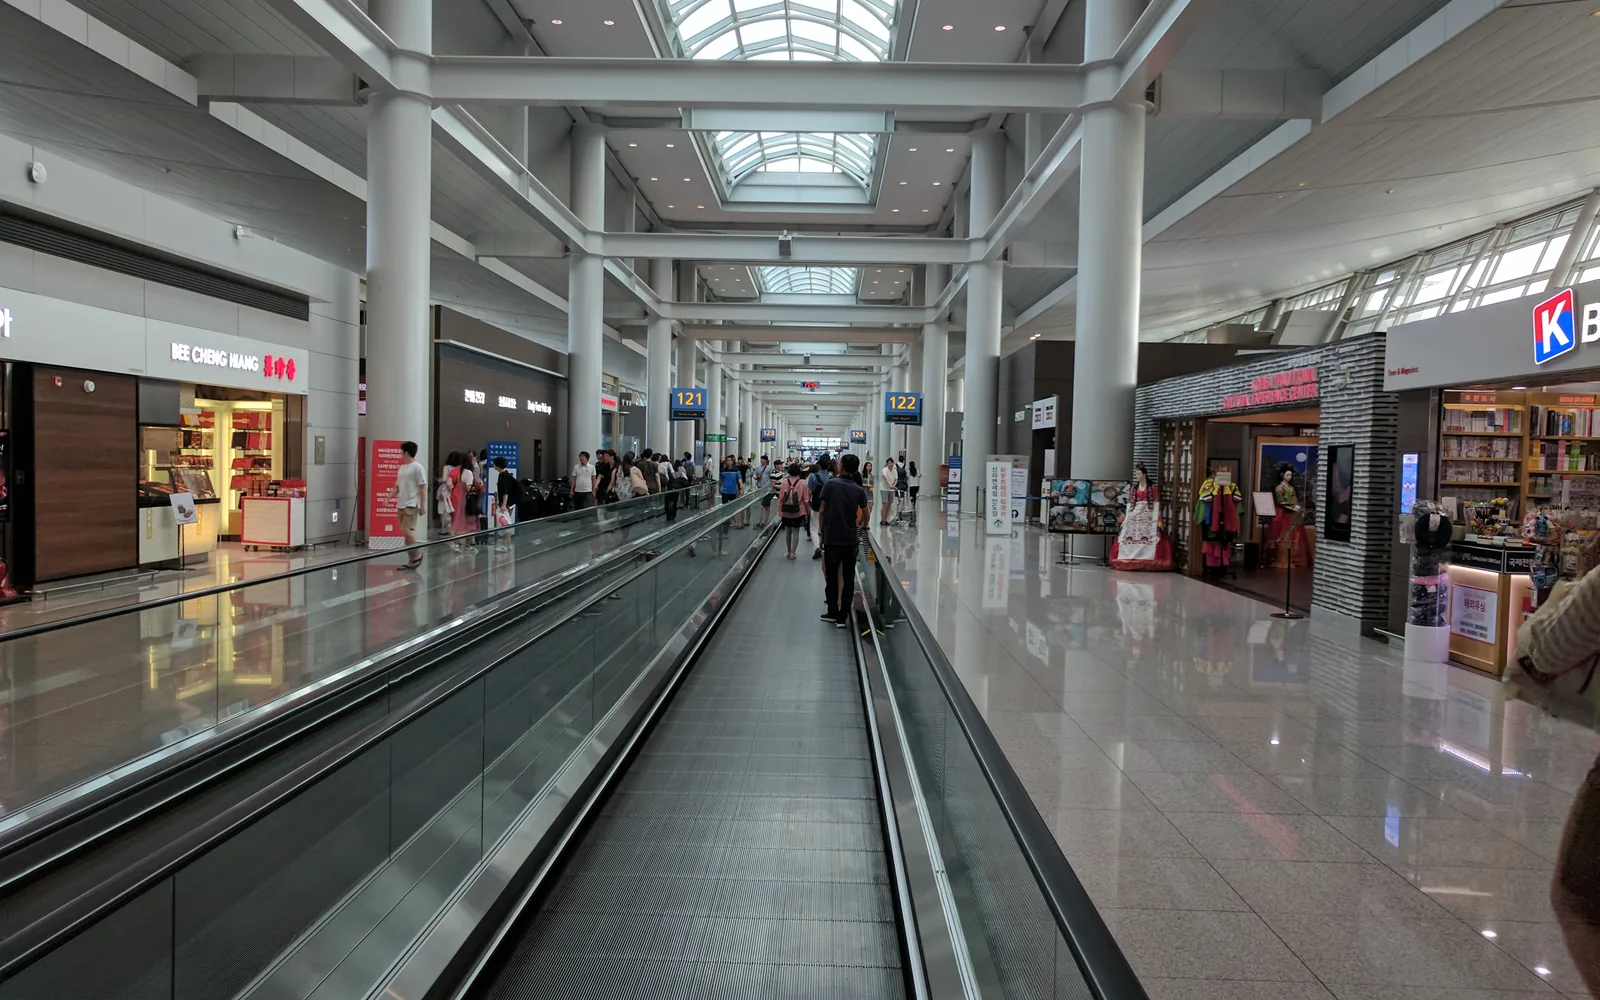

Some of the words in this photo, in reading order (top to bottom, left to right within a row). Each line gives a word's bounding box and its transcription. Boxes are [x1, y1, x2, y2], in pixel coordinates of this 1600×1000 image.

[1541, 300, 1569, 354] K
[171, 343, 189, 361] BEE
[191, 346, 228, 367] CHENG
[228, 352, 259, 372] HIANG
[677, 391, 703, 406] 121
[889, 395, 916, 410] 122
[763, 429, 775, 437] 123
[852, 431, 864, 439] 124
